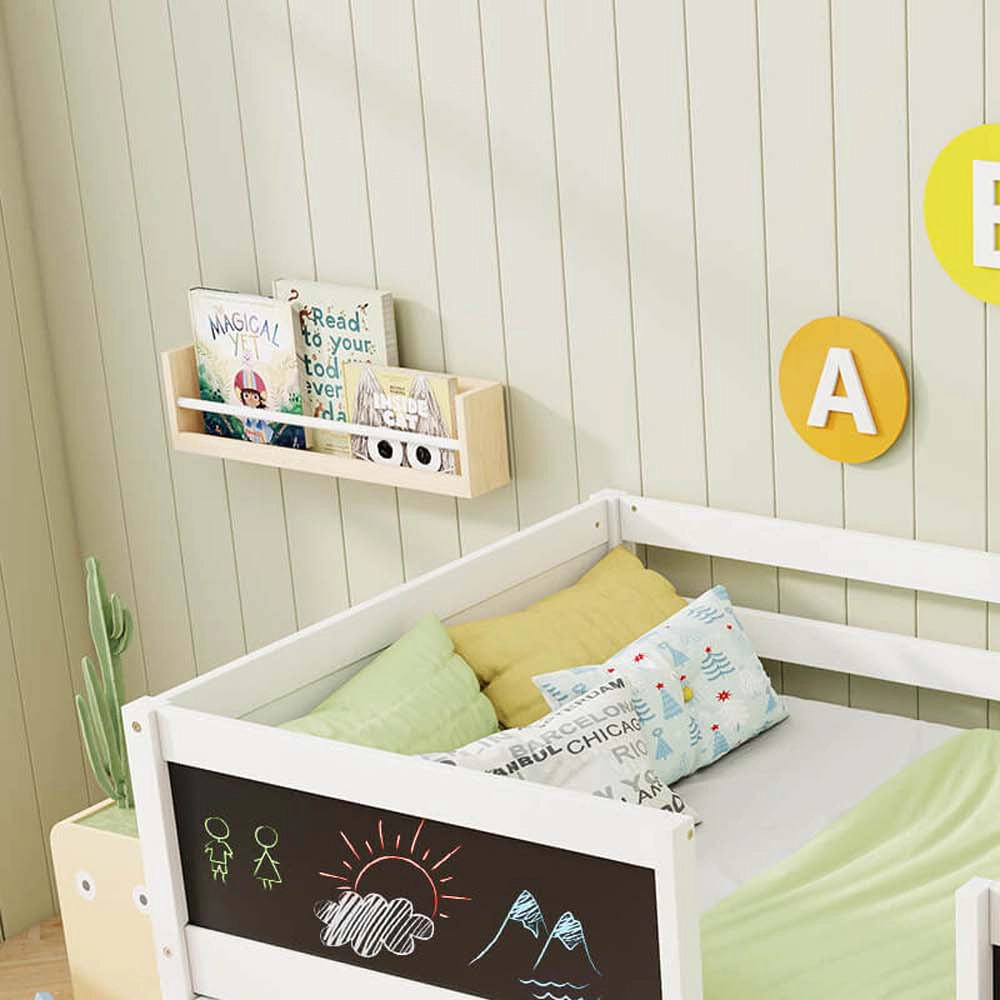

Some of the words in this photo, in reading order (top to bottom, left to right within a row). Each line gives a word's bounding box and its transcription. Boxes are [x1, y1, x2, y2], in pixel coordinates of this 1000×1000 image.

[207, 311, 280, 348] MAGICAL
[311, 306, 361, 333] Read
[228, 332, 261, 361] YET
[304, 325, 323, 348] to
[330, 335, 372, 357] your
[805, 347, 879, 434] A
[508, 698, 637, 759] BARCELON
[484, 744, 563, 776] ANBUL
